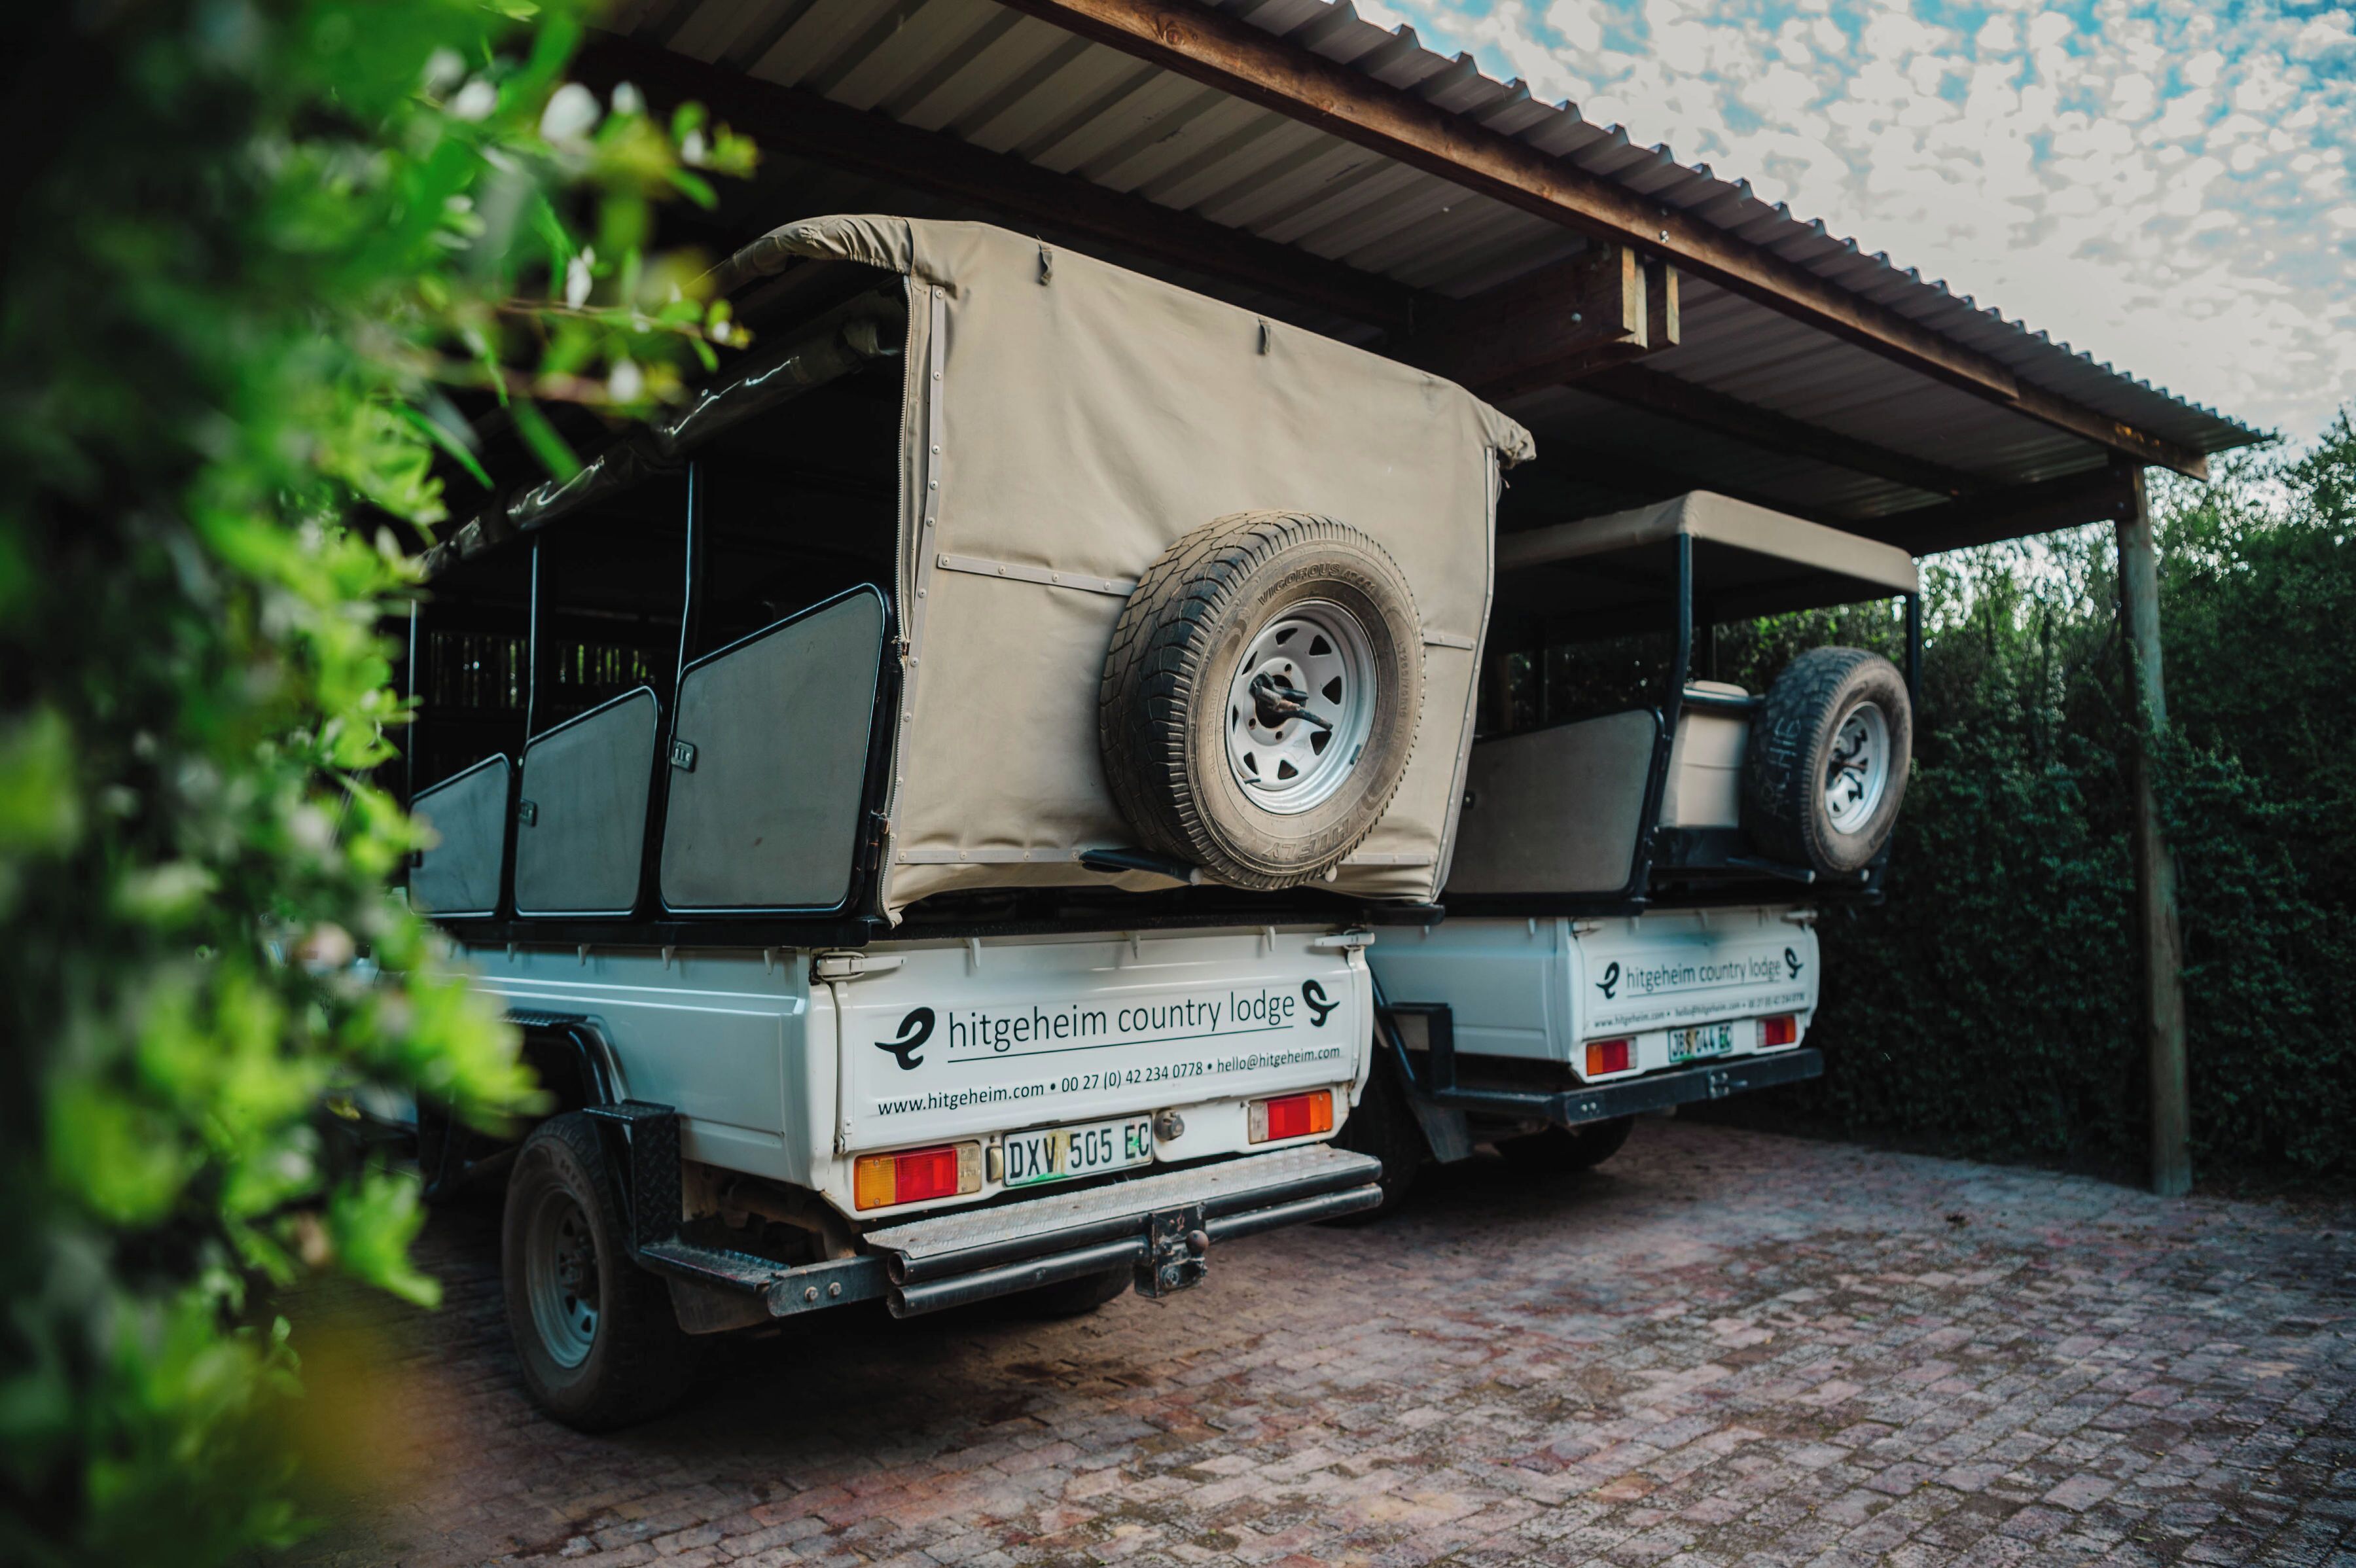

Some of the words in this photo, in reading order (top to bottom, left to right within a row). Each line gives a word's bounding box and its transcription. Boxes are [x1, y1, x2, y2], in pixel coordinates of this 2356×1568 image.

[1257, 563, 1340, 606] VIGOROUS
[1262, 818, 1349, 860] HIFLY
[1626, 963, 1696, 992] hitgeheim
[1700, 962, 1747, 982] country
[1749, 955, 1781, 981] lodge
[949, 1005, 1107, 1052] hitgeheim
[1118, 999, 1221, 1032] country
[1230, 989, 1295, 1025] lodge
[1719, 1025, 1731, 1049] EC
[878, 1082, 1044, 1115] www.hitgeheim.com
[1062, 1077, 1079, 1092] 00
[1082, 1075, 1099, 1090] 27
[1103, 1071, 1122, 1090] (0)
[1125, 1069, 1141, 1084] 42
[1146, 1065, 1169, 1082] 234
[1173, 1061, 1203, 1078] 0778
[1217, 1046, 1340, 1073] hello@hitgeheim.com
[1009, 1137, 1056, 1179] DXV
[1069, 1128, 1113, 1169] 505
[1124, 1122, 1149, 1160] EC
